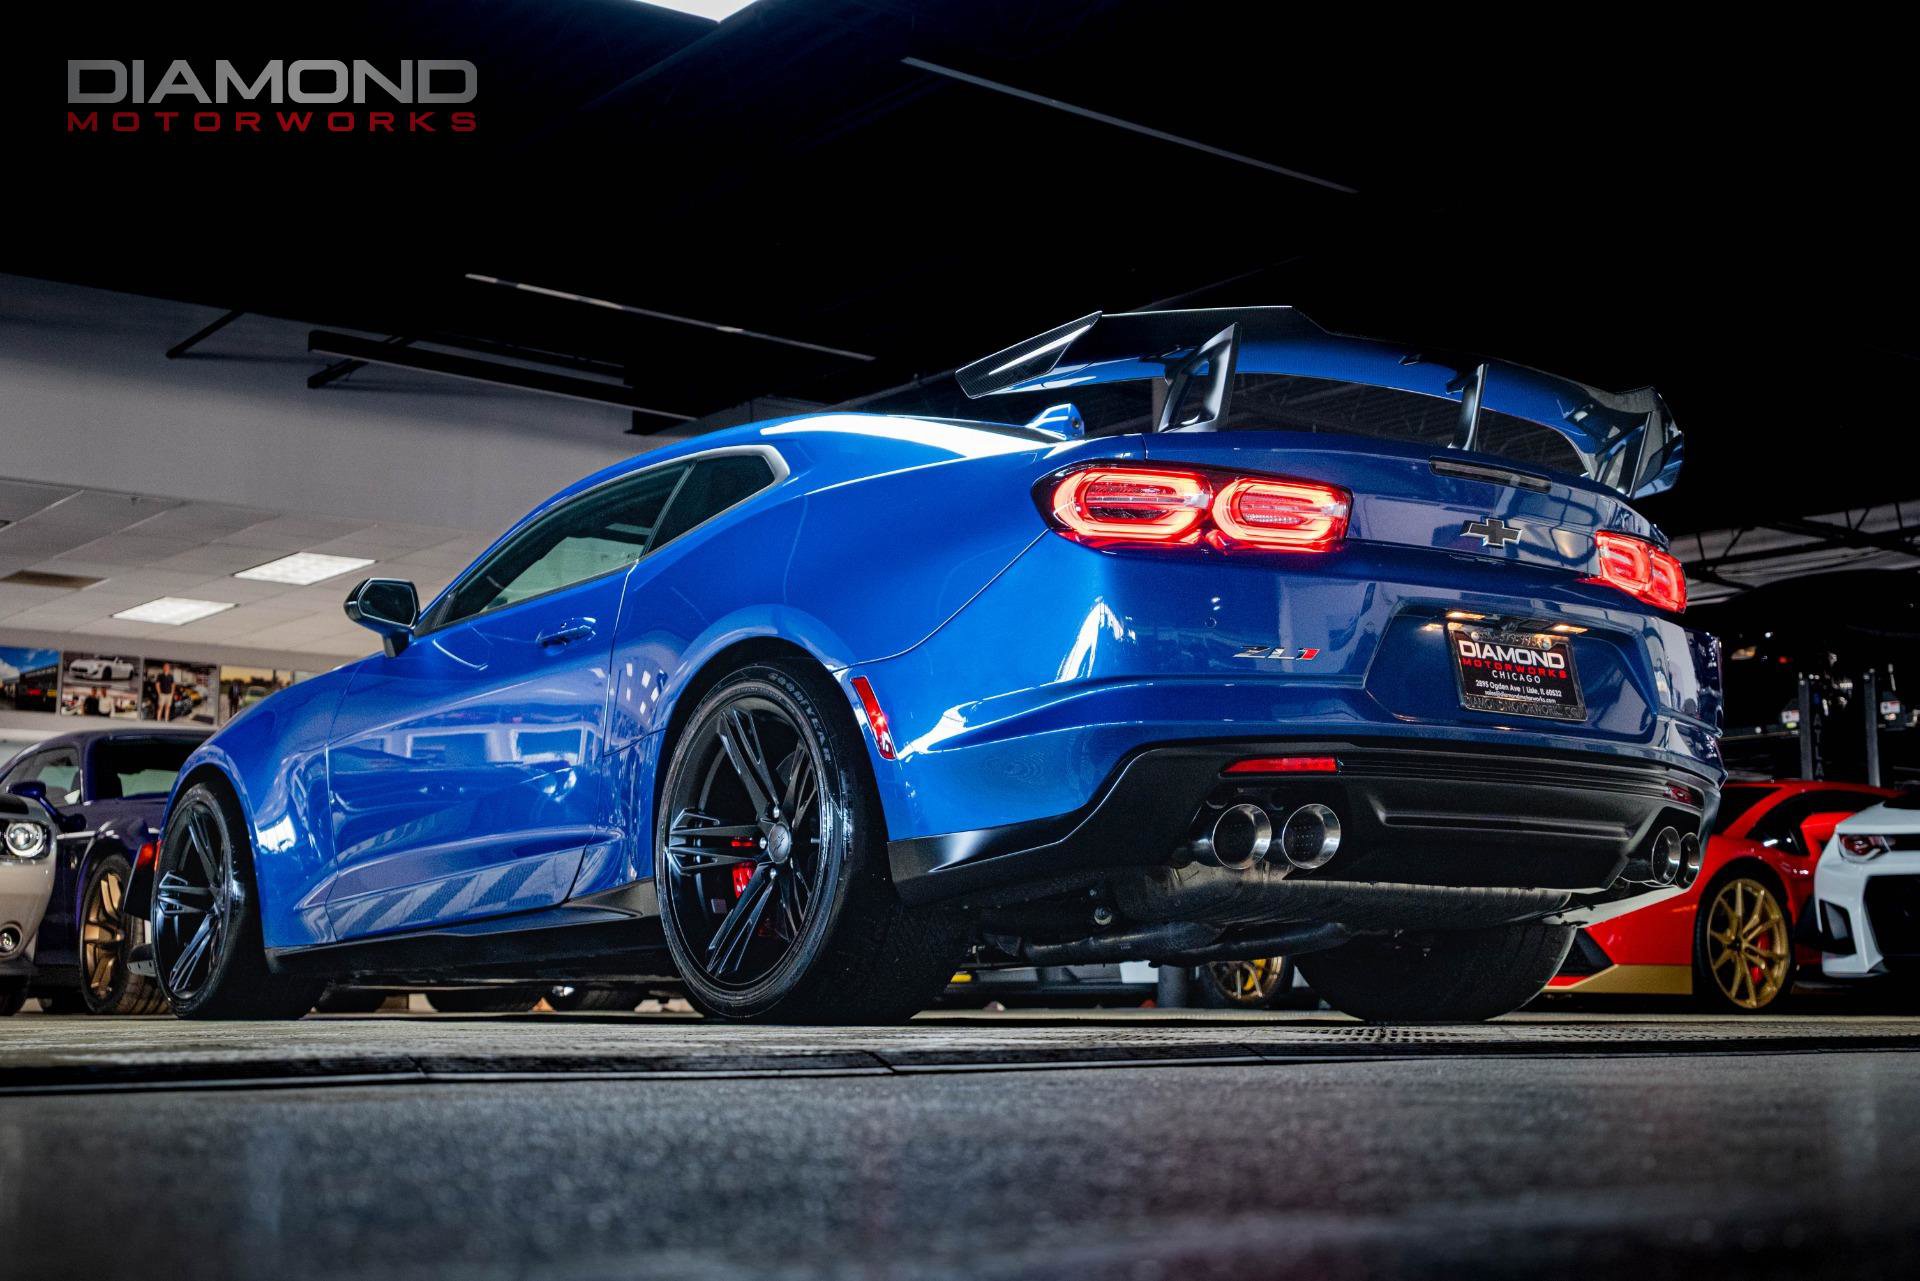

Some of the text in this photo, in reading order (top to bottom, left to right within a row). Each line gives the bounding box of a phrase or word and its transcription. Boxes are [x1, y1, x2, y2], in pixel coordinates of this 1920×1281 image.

[1232, 645, 1320, 661] ZL1
[1458, 640, 1565, 669] DIAMOND
[1461, 658, 1567, 679] MOTORWORKS
[1491, 669, 1541, 684] CHICAGO
[1489, 681, 1509, 691] Ogden
[1510, 684, 1521, 692] Ave
[768, 672, 832, 764] GOODYEAR
[1813, 714, 1824, 777] ATLA
